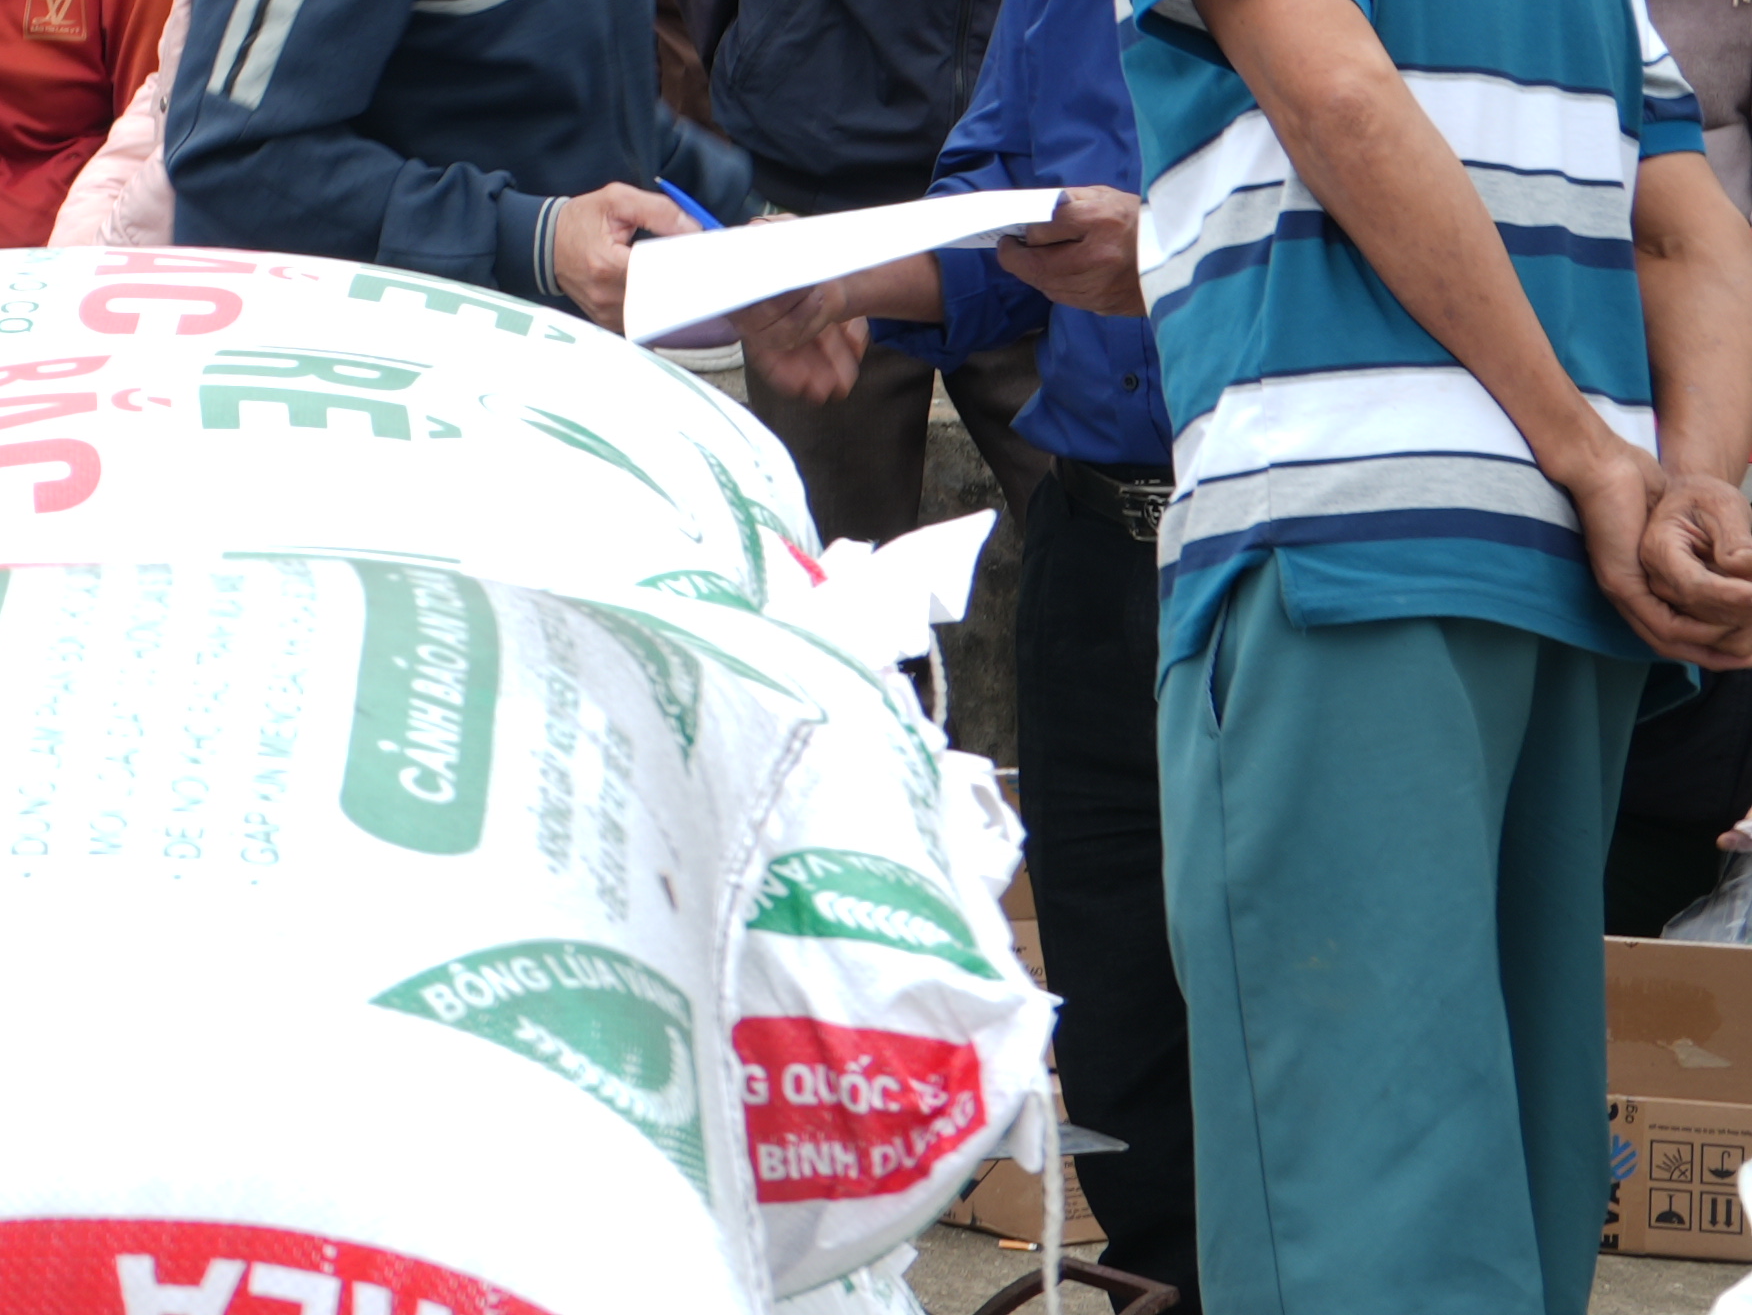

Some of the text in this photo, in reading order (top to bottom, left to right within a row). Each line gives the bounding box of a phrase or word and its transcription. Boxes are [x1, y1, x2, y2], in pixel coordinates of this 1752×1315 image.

[379, 697, 457, 804] CẢNH
[421, 947, 543, 1024] BÔNG
[781, 1055, 902, 1115] QUỐC
[756, 1132, 860, 1182] BÌNH
